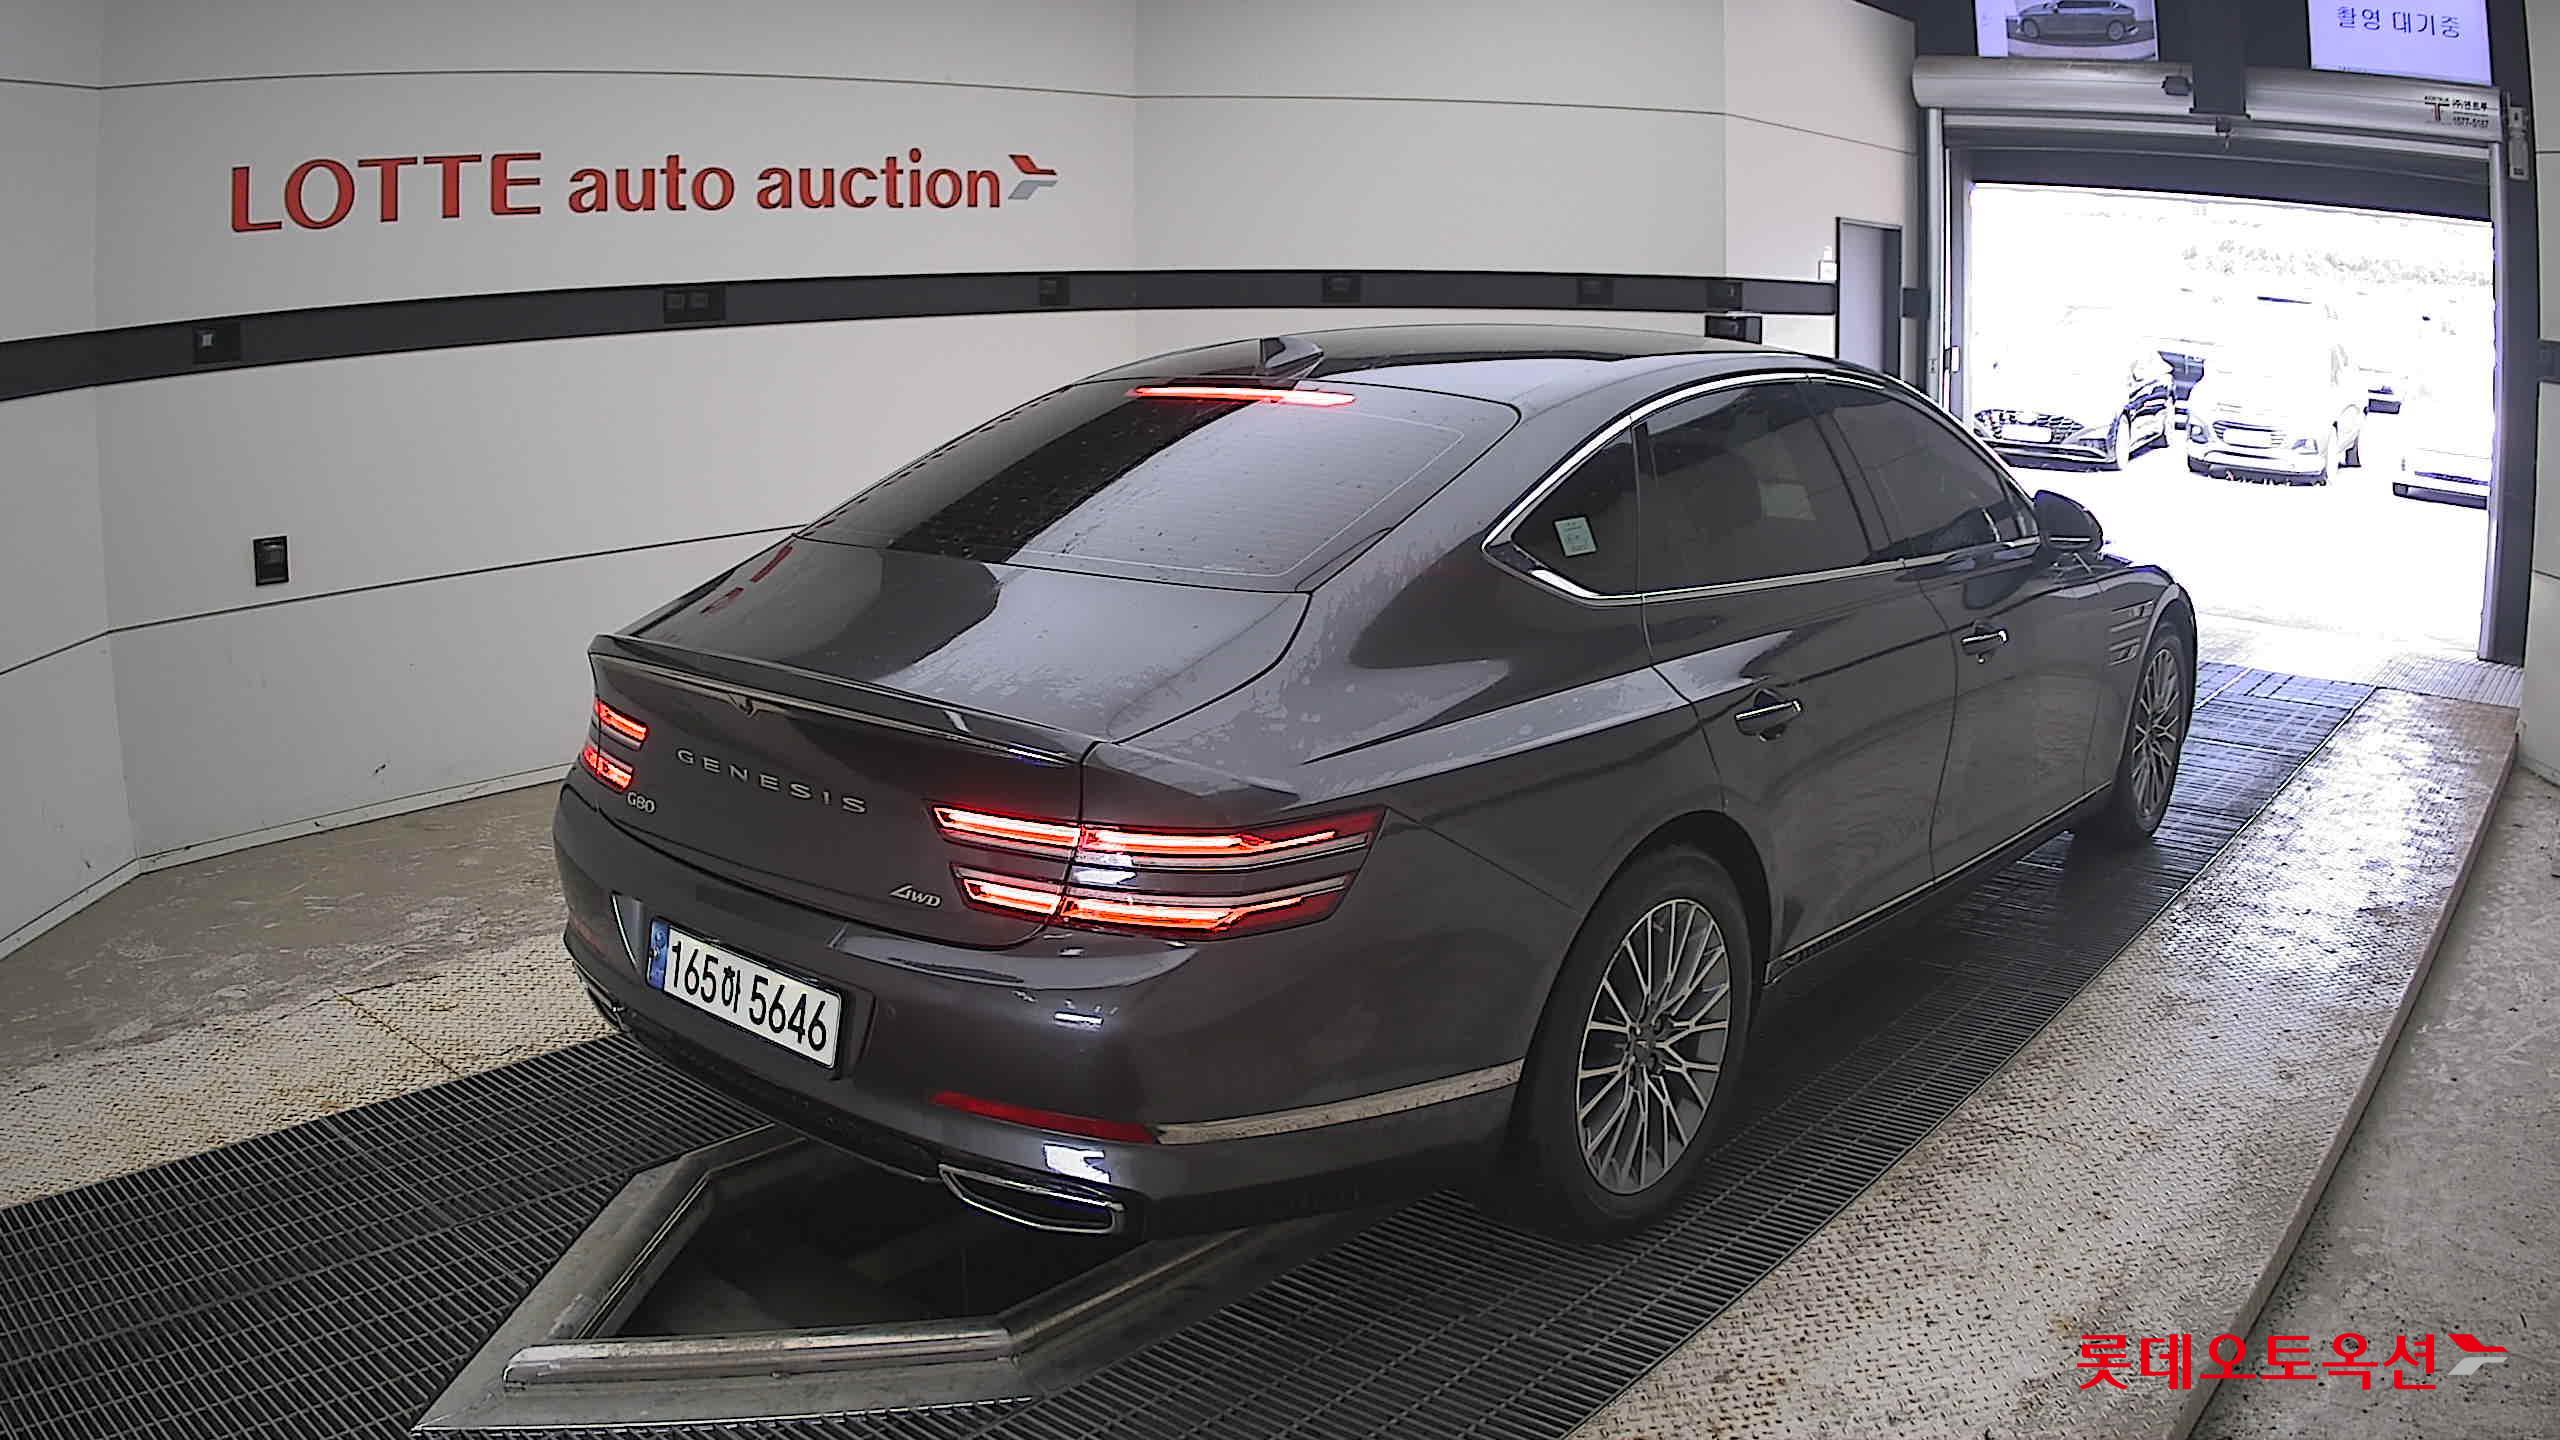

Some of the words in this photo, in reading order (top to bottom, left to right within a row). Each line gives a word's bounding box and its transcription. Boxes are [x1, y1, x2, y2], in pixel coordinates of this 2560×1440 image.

[2338, 6, 2381, 31] 촬영
[2392, 12, 2460, 39] 대기중
[231, 152, 541, 232] LOTTE
[568, 154, 735, 213] auto
[756, 148, 1000, 208] auction
[626, 791, 655, 813] G80
[677, 749, 866, 813] GENESIS
[749, 974, 827, 1052] 5646
